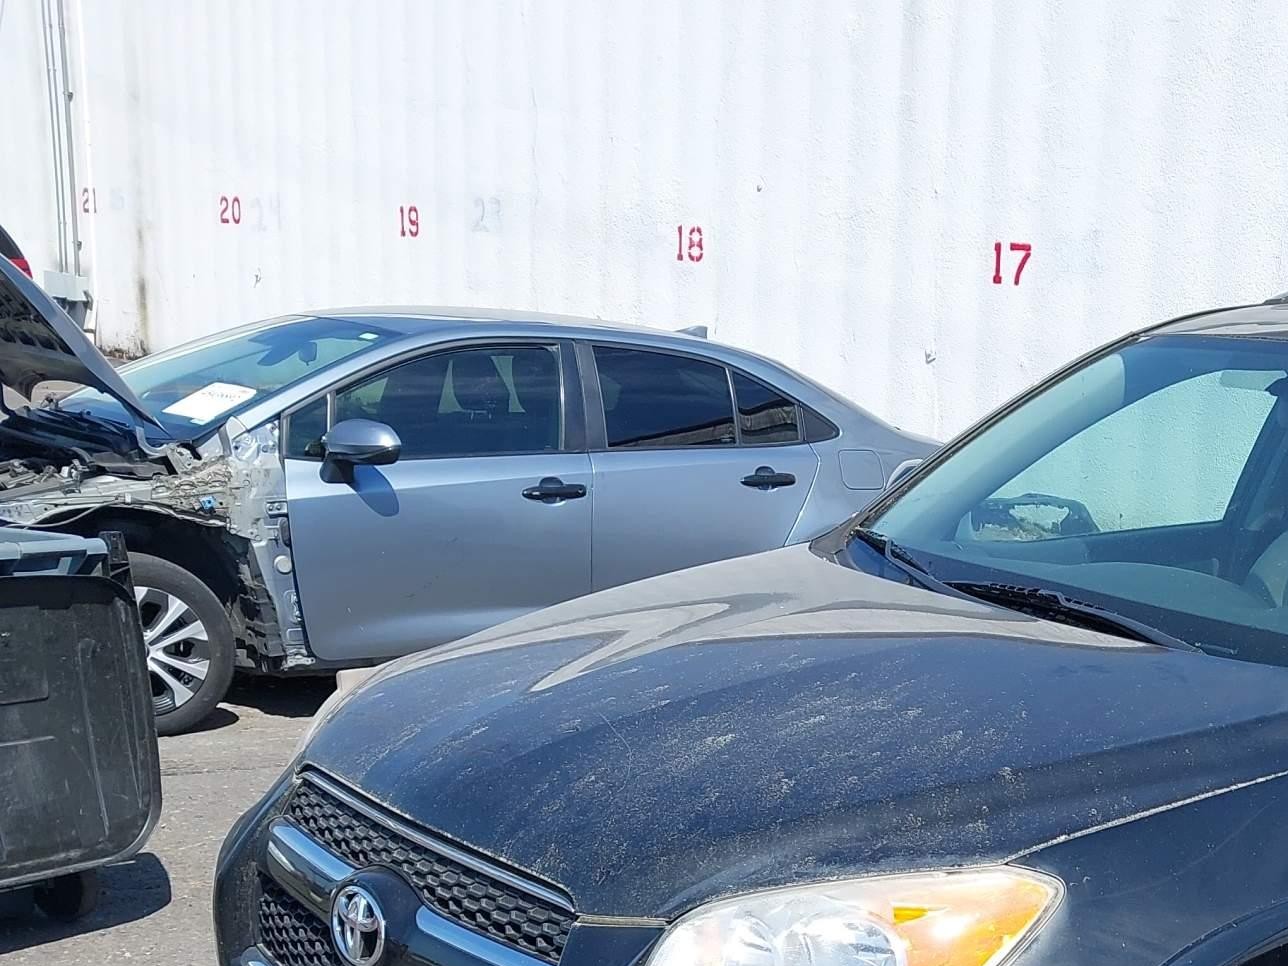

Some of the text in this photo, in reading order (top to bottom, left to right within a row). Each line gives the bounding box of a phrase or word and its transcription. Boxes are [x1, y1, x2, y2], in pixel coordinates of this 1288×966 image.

[82, 187, 97, 213] 21
[219, 196, 241, 224] 20
[400, 205, 419, 237] 19
[677, 224, 704, 262] 18
[993, 241, 1031, 286] 17
